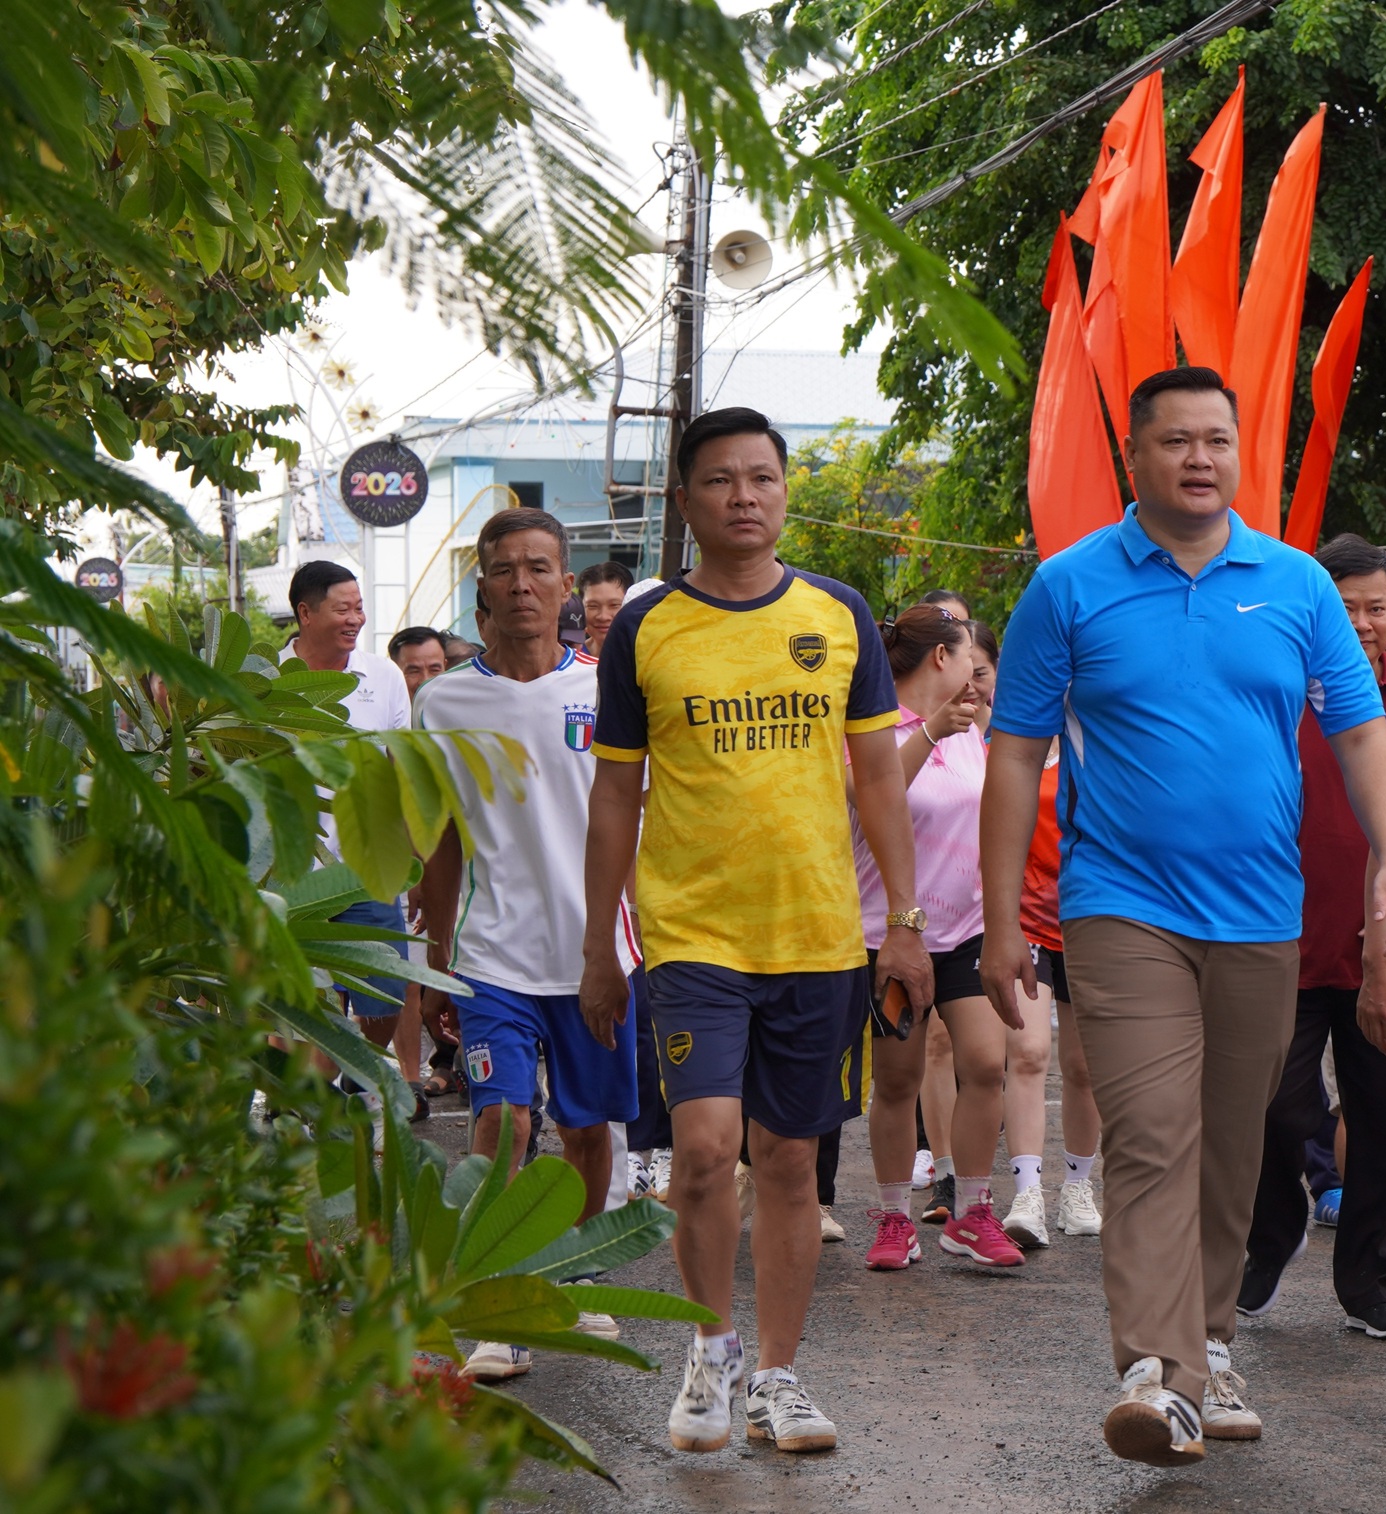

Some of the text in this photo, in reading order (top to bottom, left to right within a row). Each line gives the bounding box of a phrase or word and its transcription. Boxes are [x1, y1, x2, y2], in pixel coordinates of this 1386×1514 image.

[351, 471, 419, 497] 2026
[79, 572, 118, 588] 2026
[567, 714, 593, 722] ITALIA
[682, 689, 831, 727] Emirates
[714, 723, 811, 754] FLY BETTER
[469, 1052, 488, 1063] ITALIA
